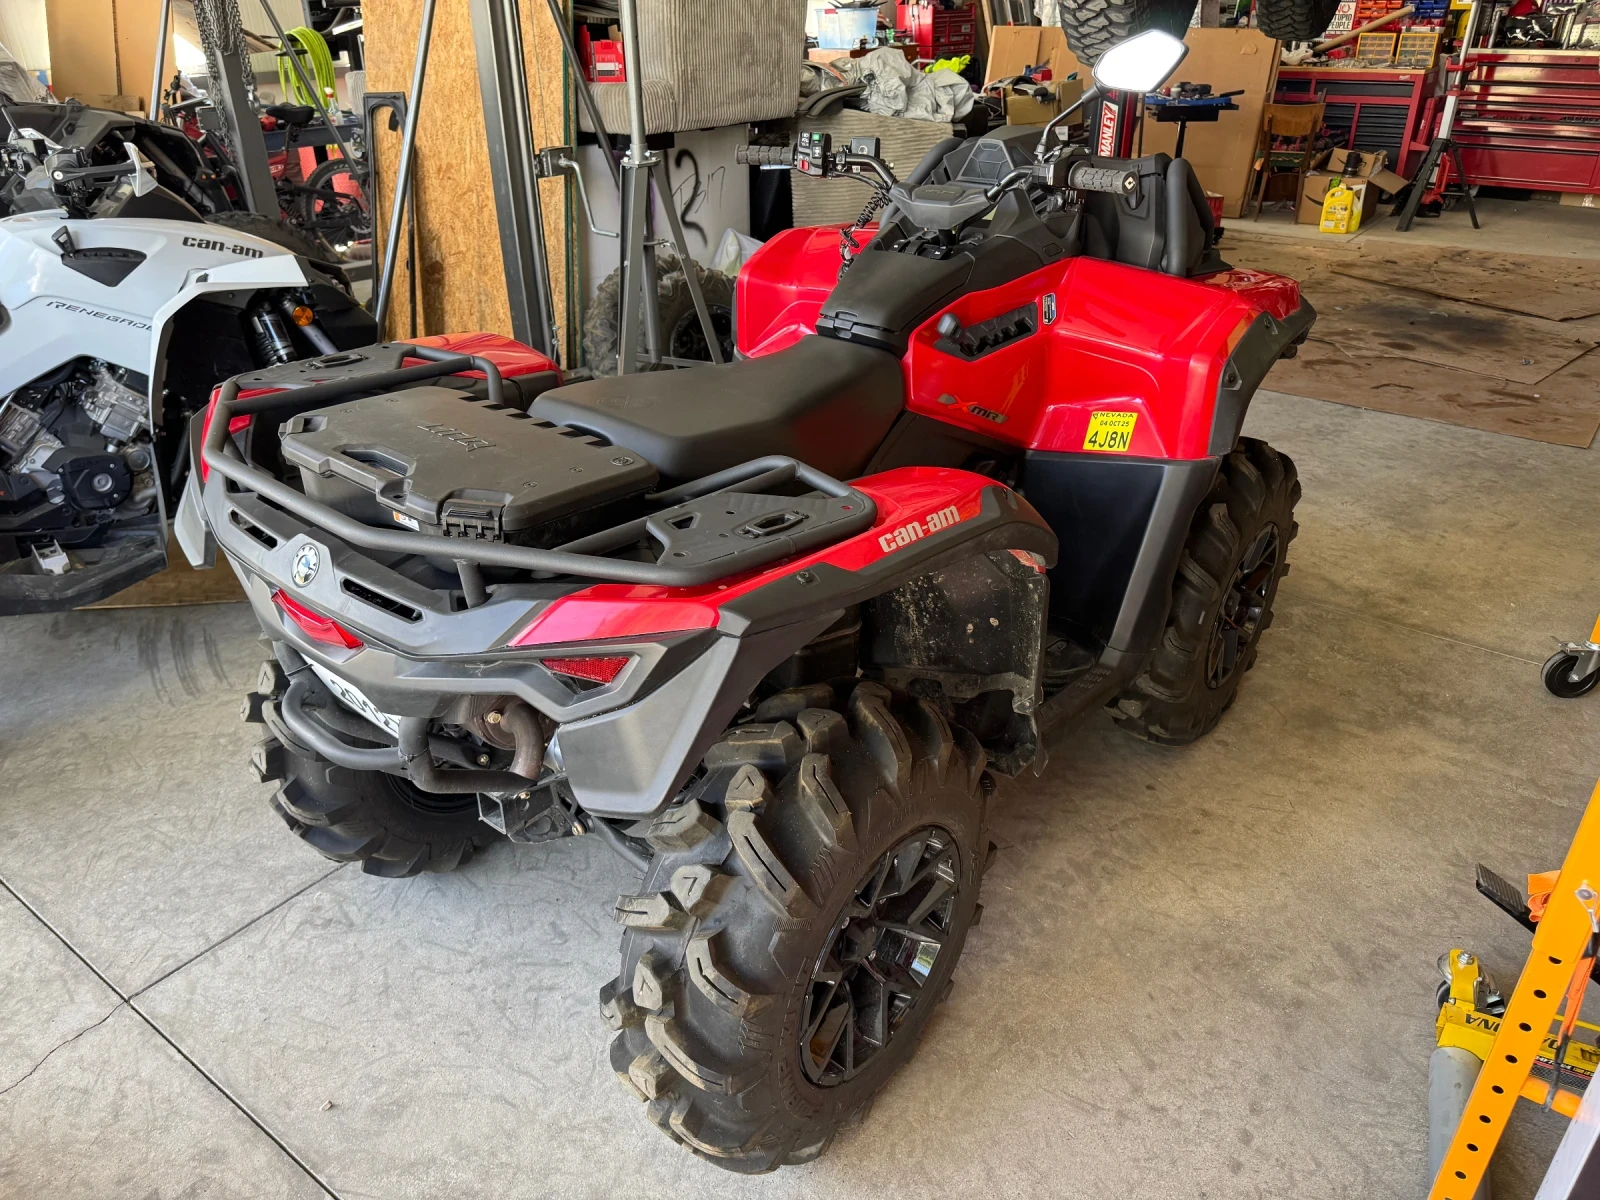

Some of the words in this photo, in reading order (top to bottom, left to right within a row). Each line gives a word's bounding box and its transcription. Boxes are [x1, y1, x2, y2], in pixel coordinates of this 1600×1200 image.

[1333, 13, 1352, 21] TUPID
[1100, 107, 1116, 157] MANLEY
[182, 236, 264, 259] can-am
[1088, 430, 1130, 449] 4J8N
[878, 505, 961, 553] can-am
